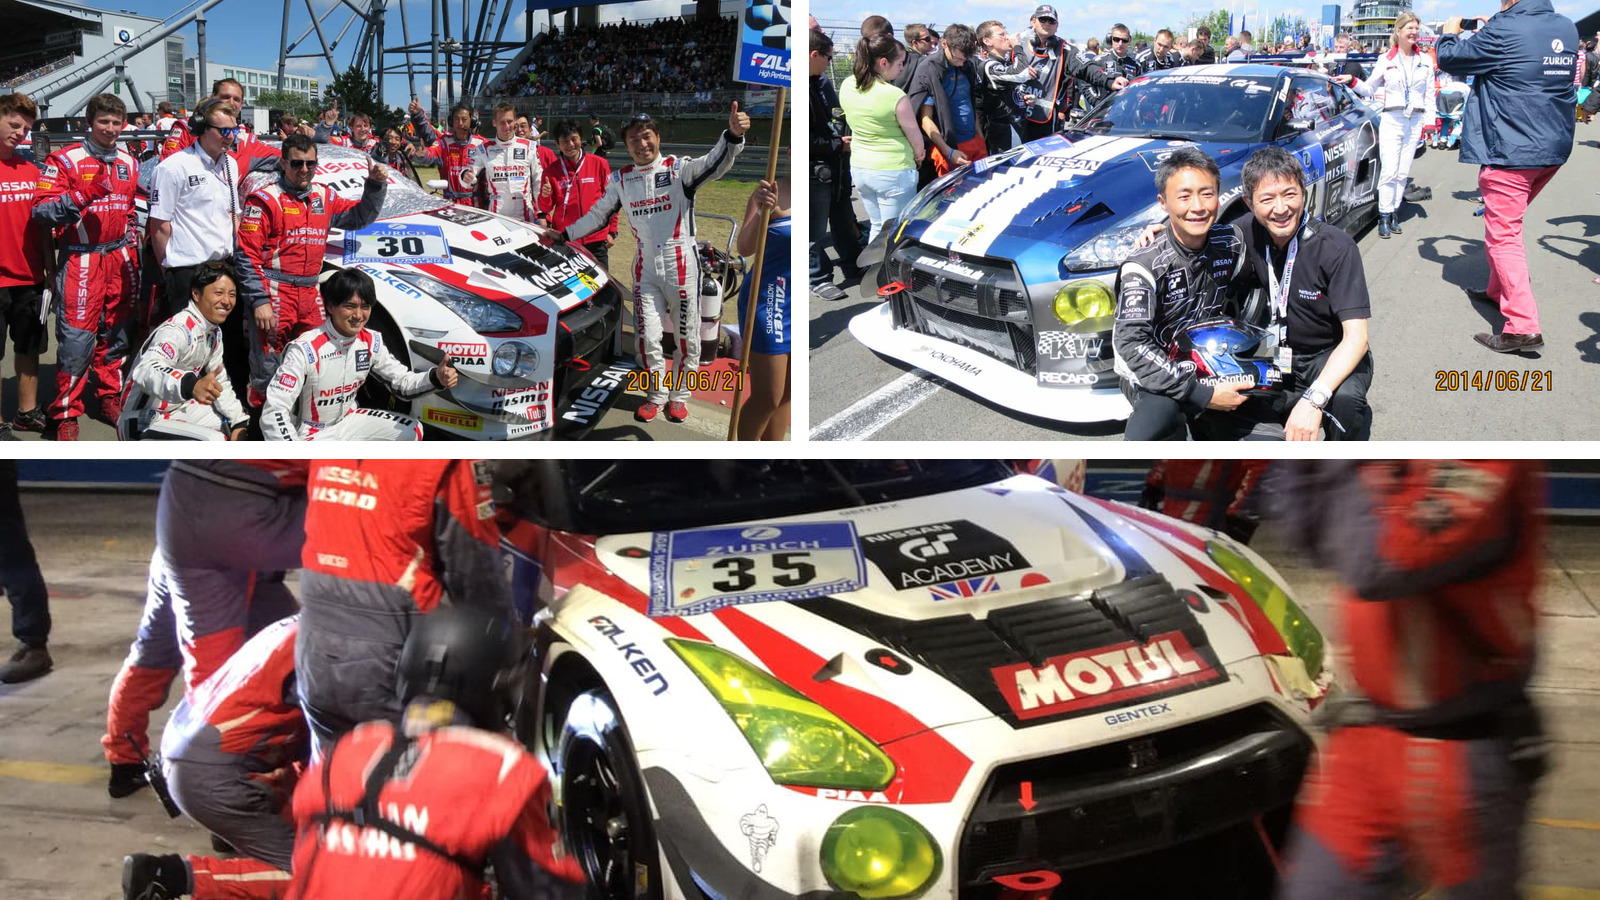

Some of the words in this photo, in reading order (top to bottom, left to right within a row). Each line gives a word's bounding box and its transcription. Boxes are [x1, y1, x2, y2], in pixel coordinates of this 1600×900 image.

[1543, 56, 1573, 65] ZURICH
[1324, 138, 1355, 164] NISSAN
[1033, 156, 1103, 171] NISSAN
[629, 194, 671, 208] NISSAN
[632, 203, 673, 217] nismo
[286, 227, 326, 236] NISSAN
[377, 236, 424, 257] 30
[531, 254, 589, 289] NISSAN
[355, 264, 422, 299] FALKEN
[76, 268, 89, 320] NISSAN
[774, 275, 786, 343] FALKEN
[440, 343, 486, 355] MOTUL
[1050, 339, 1104, 360] KW
[451, 357, 486, 365] PIAA
[1135, 345, 1180, 378] NISSAN
[1039, 371, 1099, 384] RECARO
[1199, 373, 1254, 387] PlayStation
[317, 391, 358, 407] nism
[492, 392, 550, 408] nismo
[428, 408, 480, 428] PIRELLI
[511, 424, 539, 434] nismo
[865, 524, 953, 543] NISSAN
[706, 540, 820, 556] ZURICH
[713, 552, 817, 592] 35
[900, 552, 1013, 587] ACADEMY
[587, 615, 669, 696] FALKEN
[1015, 639, 1201, 710] MOTUL
[1104, 703, 1172, 725] GENTEX
[817, 788, 890, 803] PIAA
